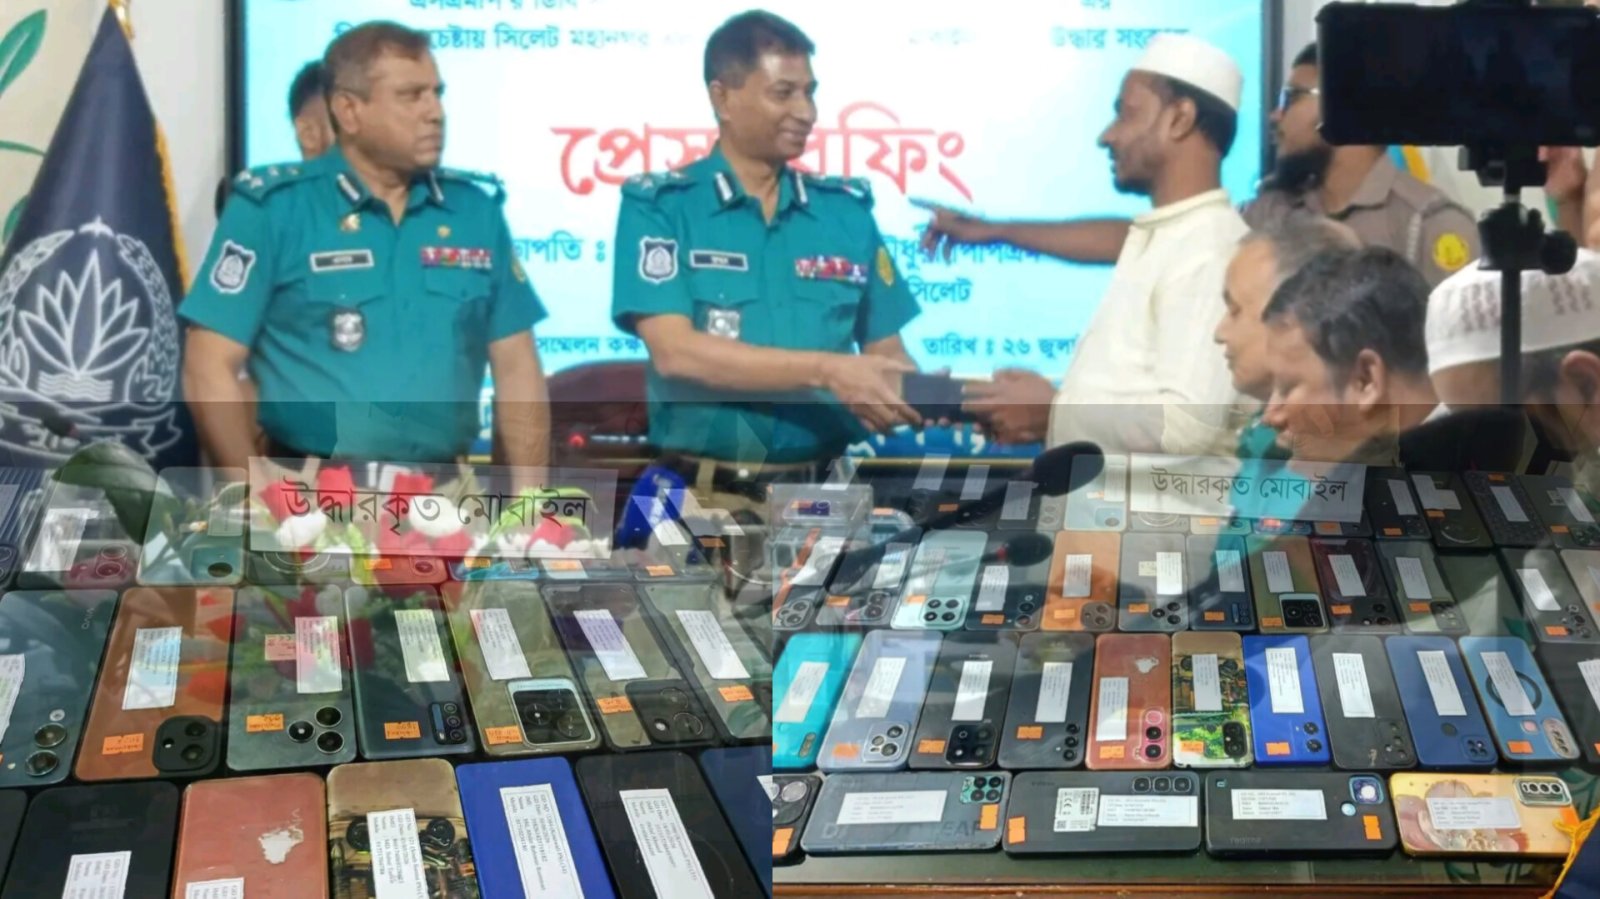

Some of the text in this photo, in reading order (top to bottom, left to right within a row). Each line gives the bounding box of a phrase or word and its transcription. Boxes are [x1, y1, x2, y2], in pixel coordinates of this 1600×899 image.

[1003, 339, 1031, 356] ২৬
[1150, 467, 1348, 505] উদ্ধারকৃত মোবাইল
[280, 475, 590, 536] উদ্ধারকৃত মোবাইল
